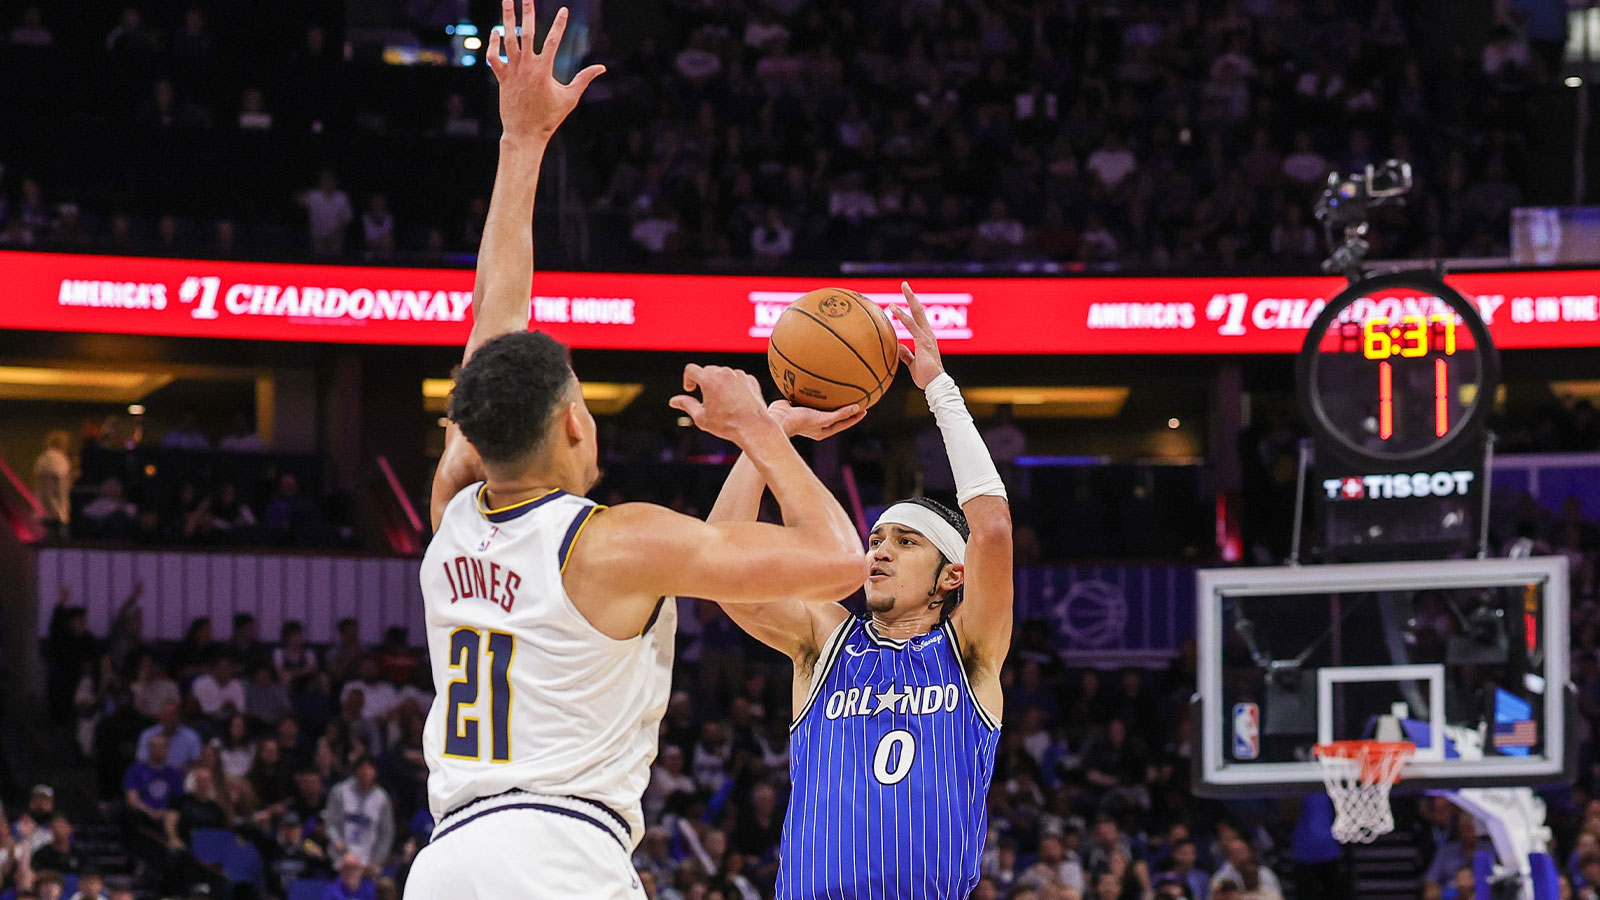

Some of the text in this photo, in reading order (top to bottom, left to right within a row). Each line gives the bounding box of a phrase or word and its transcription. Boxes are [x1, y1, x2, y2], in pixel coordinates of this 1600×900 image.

[59, 276, 635, 324] AMERICA'S #1 CHARDONNAY THE HOUSE
[1087, 302, 1195, 329] AMERICA'S
[1205, 293, 1249, 336] #1
[1511, 296, 1535, 323] IS
[1535, 296, 1559, 322] IN
[1560, 295, 1598, 321] THE
[1364, 314, 1455, 359] 6:37
[1379, 358, 1449, 440] 11
[1363, 470, 1474, 499] TISSOT
[443, 556, 521, 613] JONES
[442, 626, 516, 763] 21
[872, 729, 916, 785] 0
